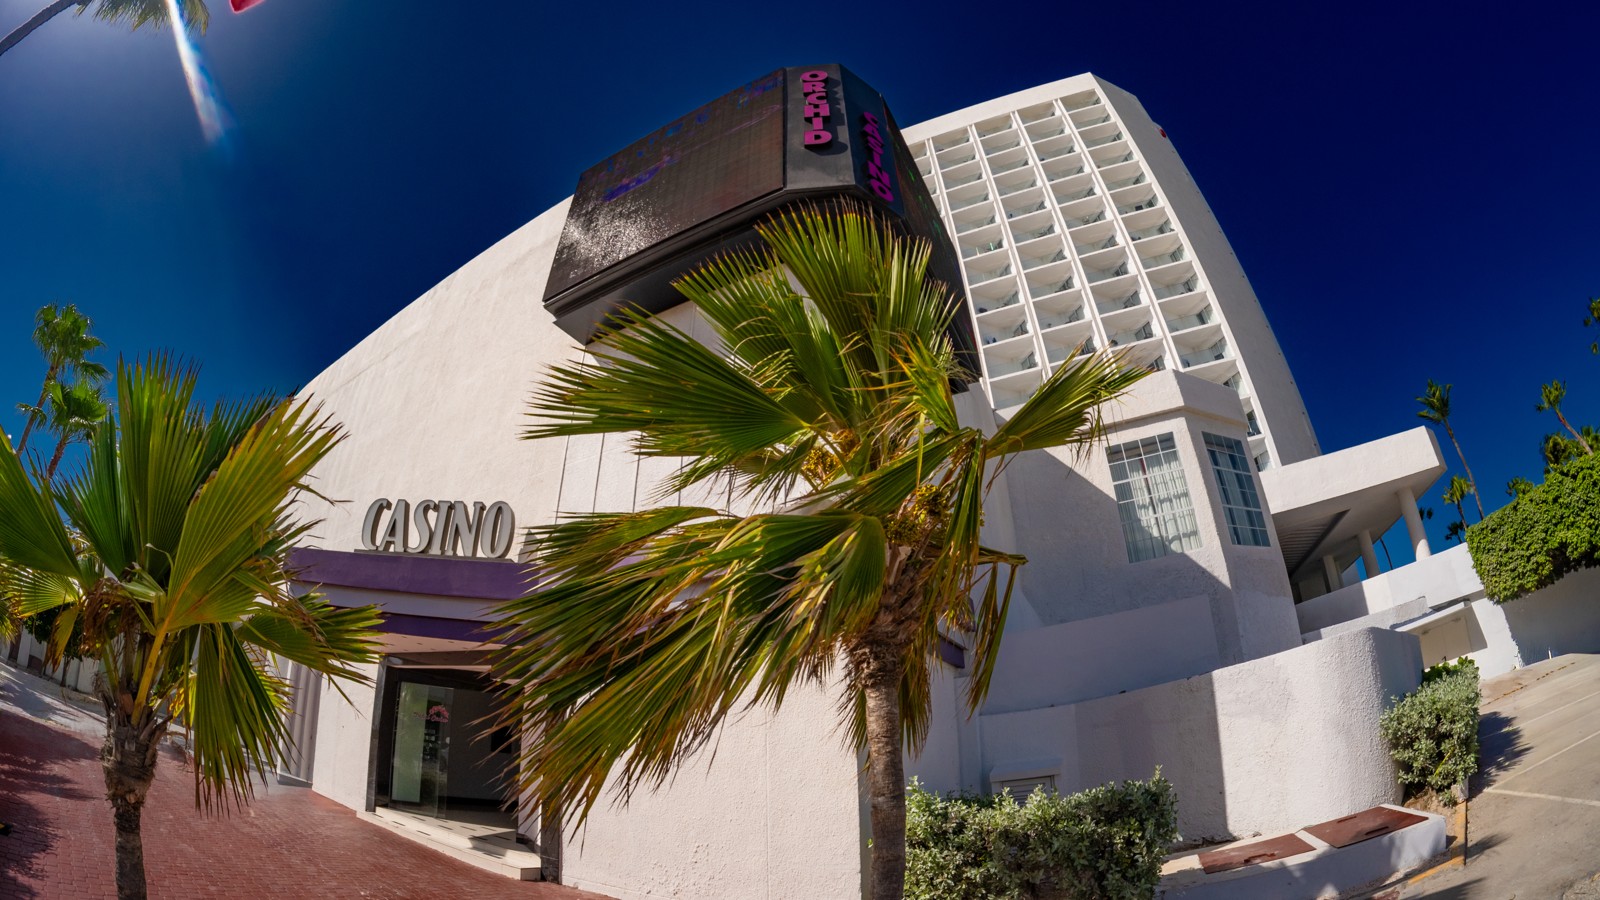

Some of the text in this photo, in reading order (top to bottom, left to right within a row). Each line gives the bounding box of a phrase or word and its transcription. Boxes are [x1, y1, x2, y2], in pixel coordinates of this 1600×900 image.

[800, 70, 833, 147] ORCHID
[862, 112, 894, 202] CASINO
[361, 498, 516, 560] CASINO
